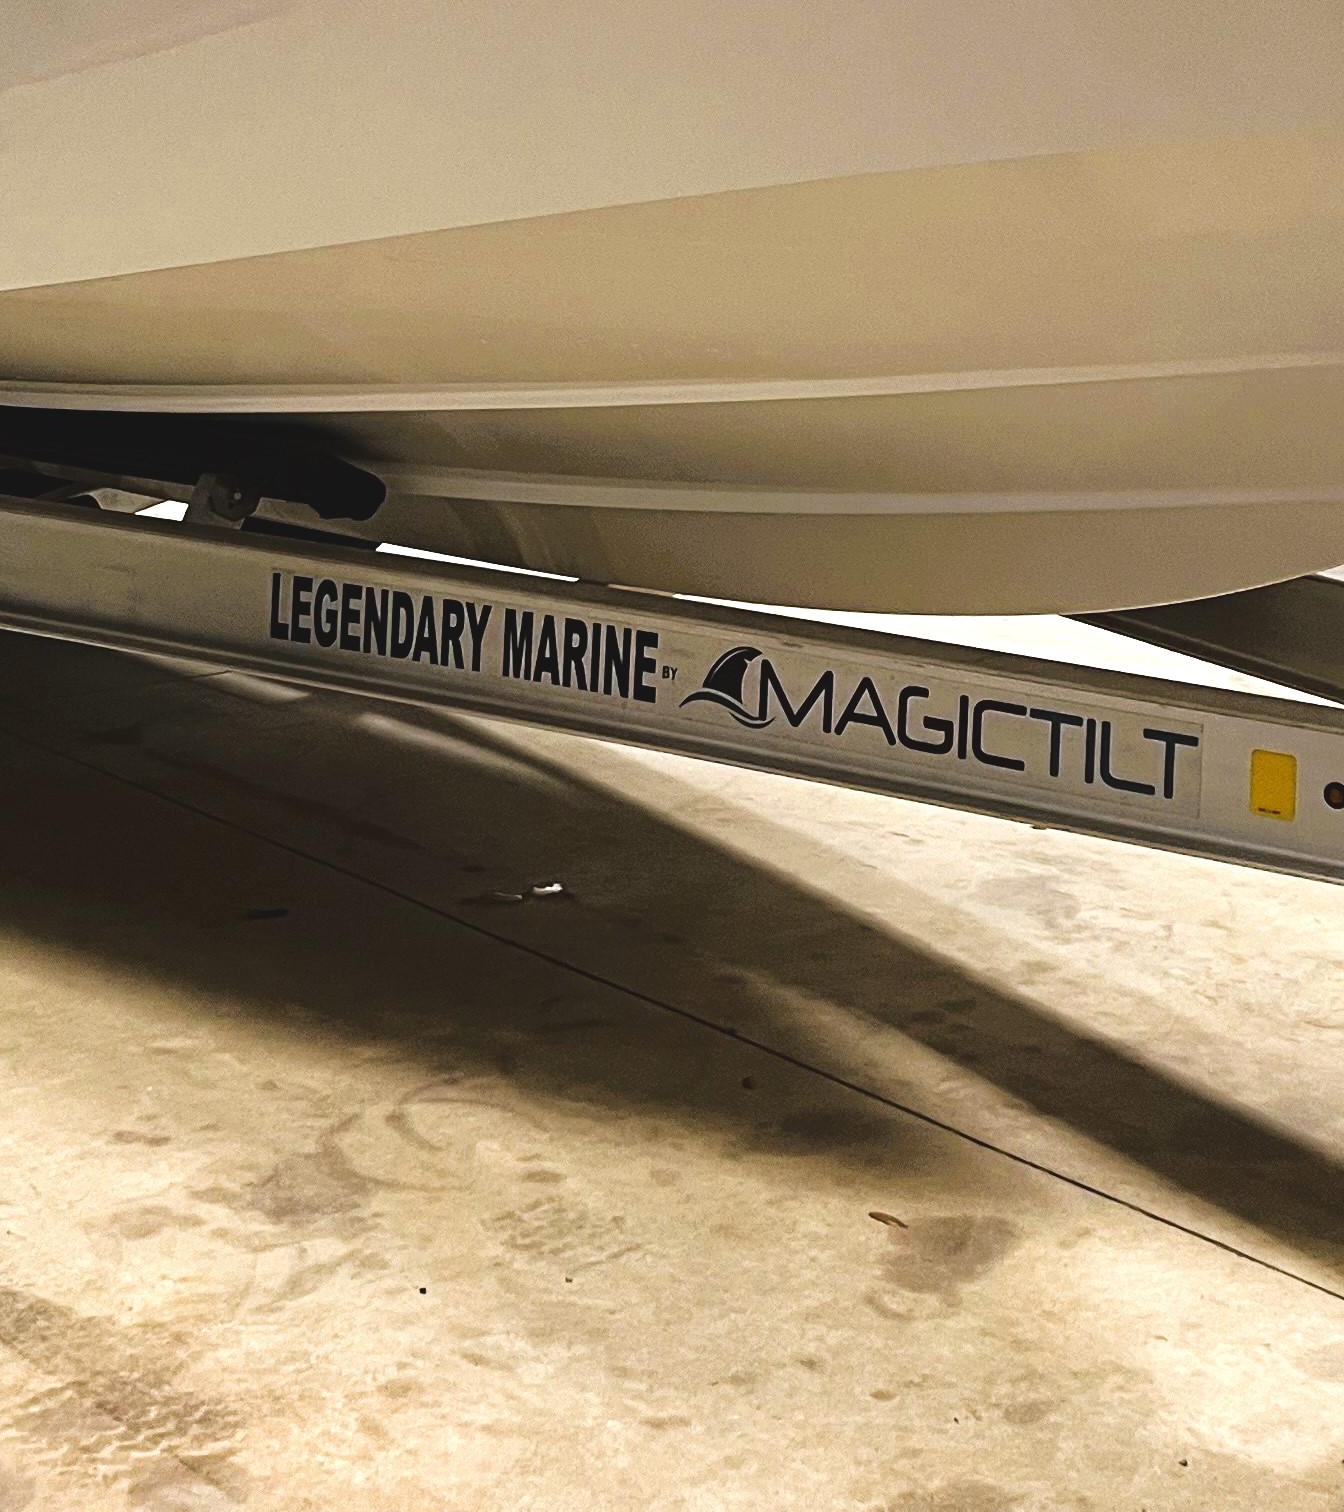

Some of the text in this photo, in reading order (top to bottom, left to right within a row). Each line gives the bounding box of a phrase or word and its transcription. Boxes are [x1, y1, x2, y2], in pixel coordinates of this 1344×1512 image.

[269, 571, 1200, 800] LEGENDARY MARINE BY MAGICTILT
